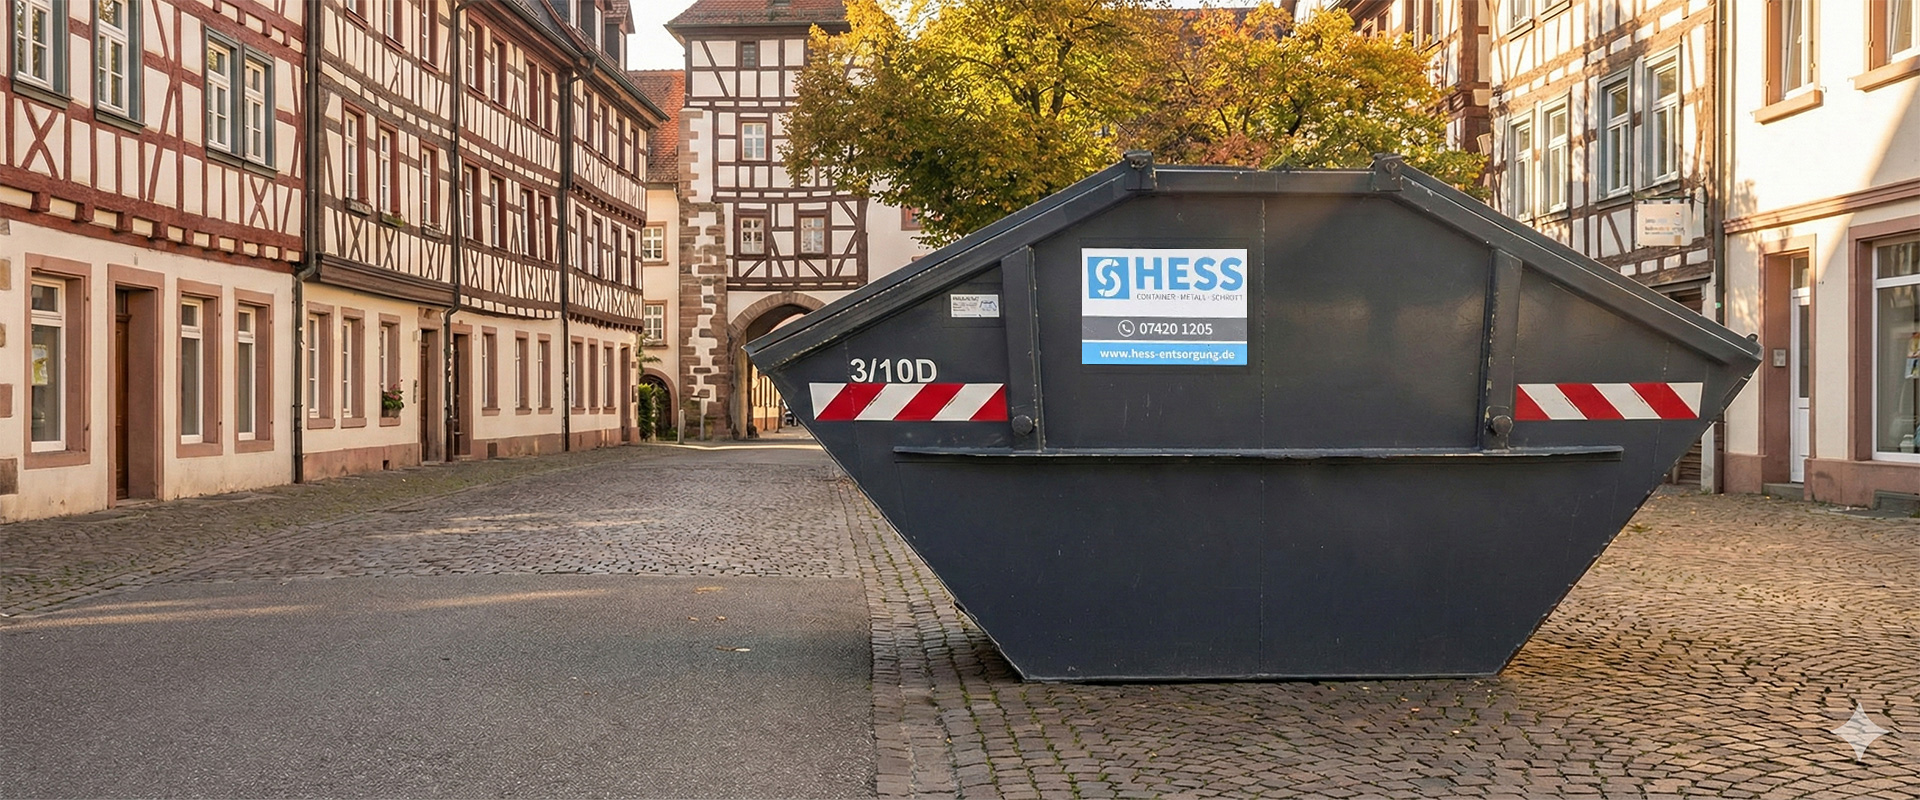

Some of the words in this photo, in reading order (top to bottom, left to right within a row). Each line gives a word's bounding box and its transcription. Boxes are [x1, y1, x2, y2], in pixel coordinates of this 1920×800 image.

[1135, 257, 1243, 291] HESS
[1136, 293, 1176, 301] CONTAINER
[1180, 293, 1206, 301] METALL
[1212, 294, 1243, 302] SCHROTT
[1139, 323, 1178, 335] 07420
[1181, 323, 1213, 335] 1205
[1100, 349, 1235, 361] www.hess-entsorgung.de
[850, 358, 938, 383] 3/10D
